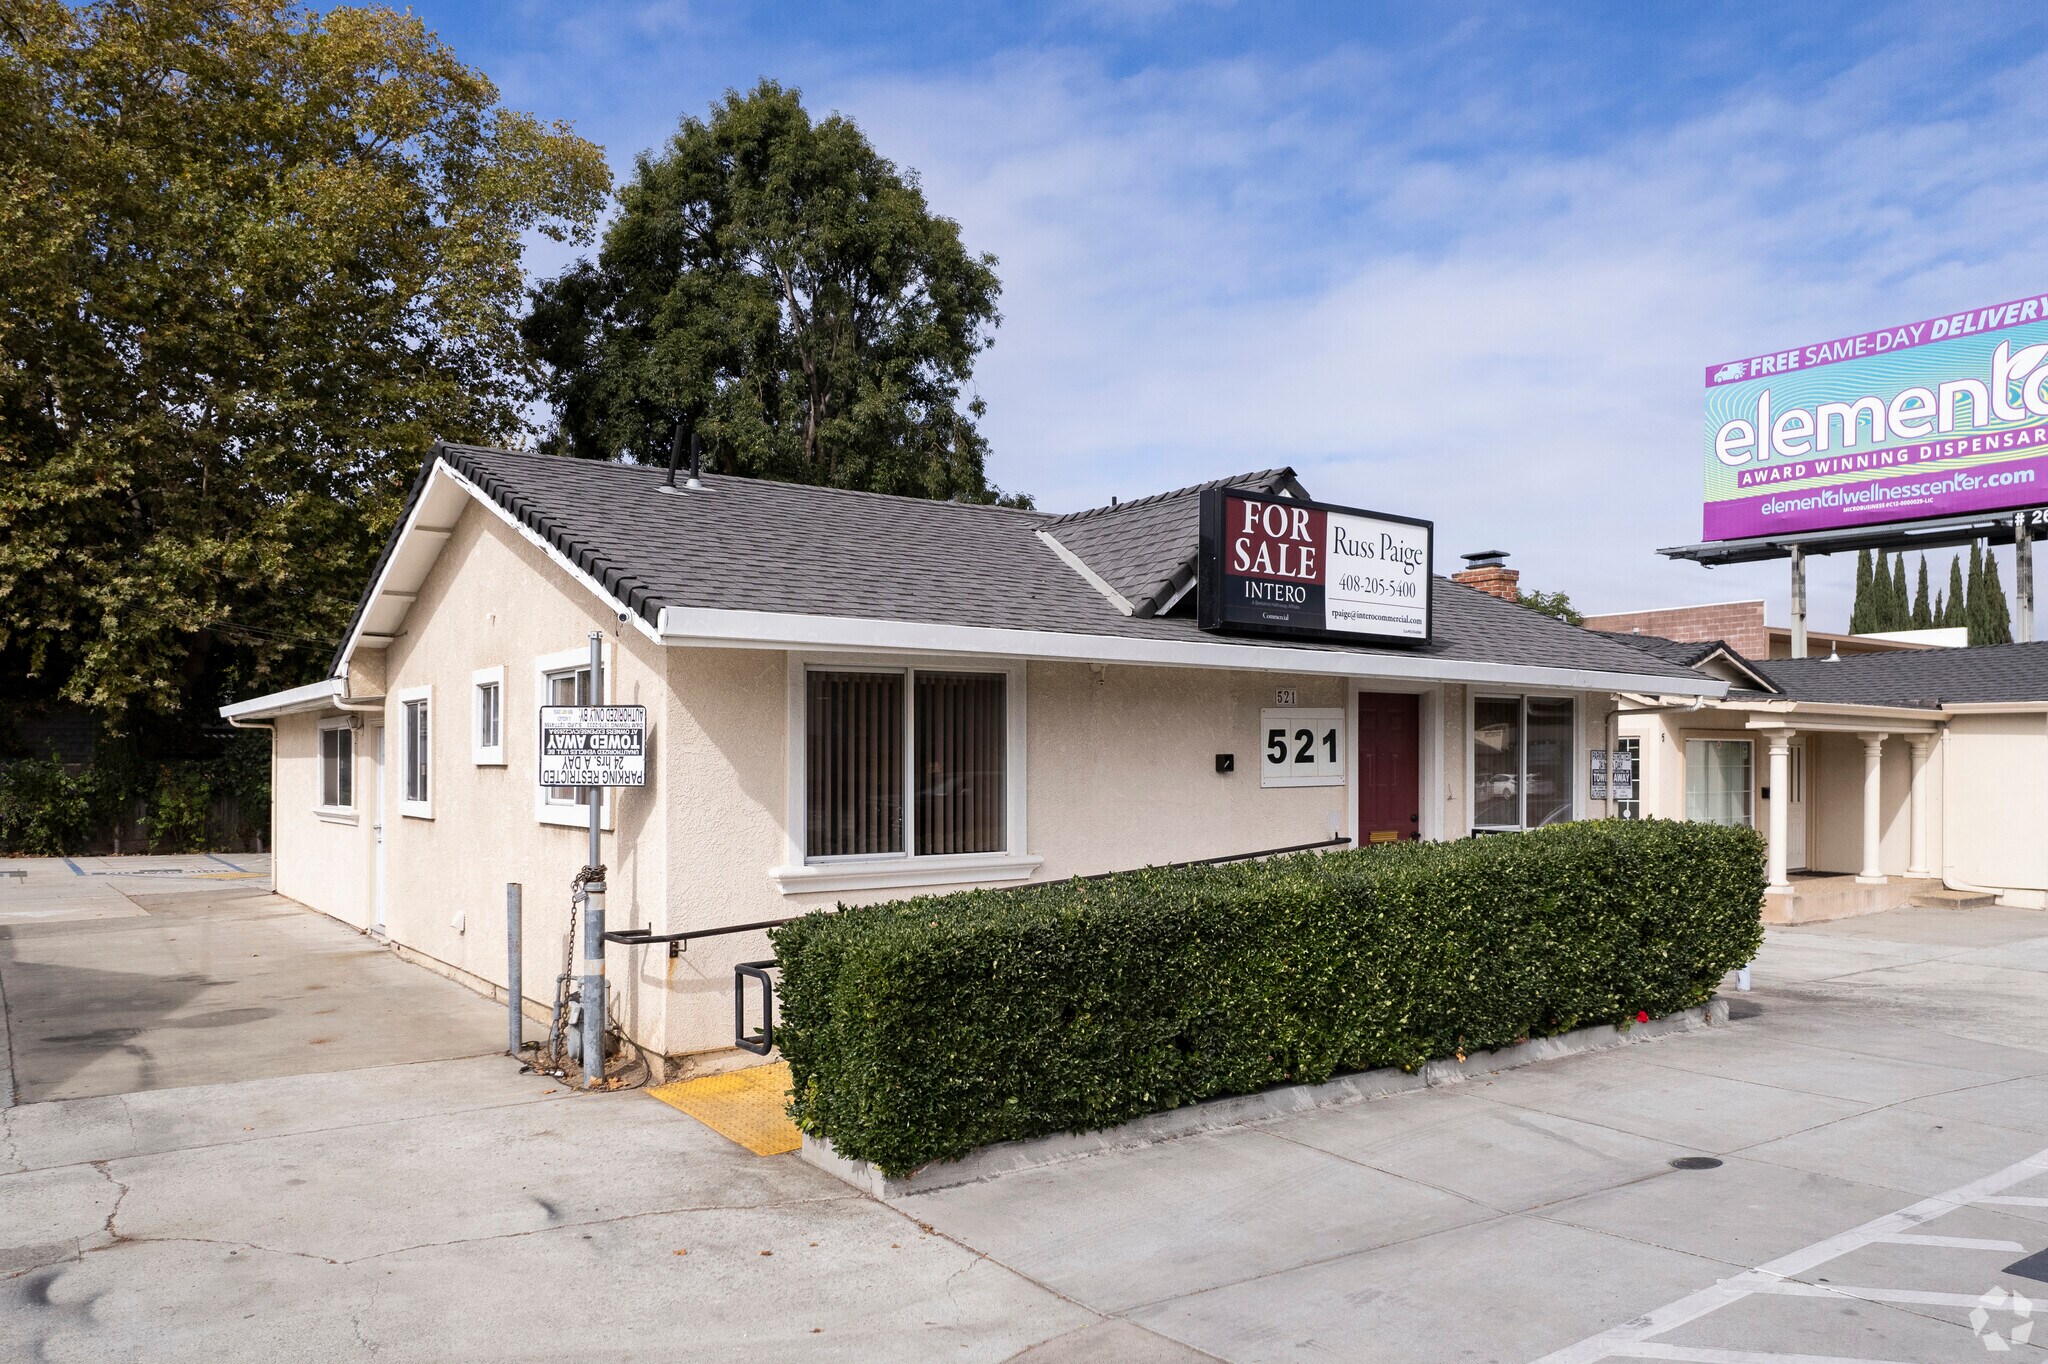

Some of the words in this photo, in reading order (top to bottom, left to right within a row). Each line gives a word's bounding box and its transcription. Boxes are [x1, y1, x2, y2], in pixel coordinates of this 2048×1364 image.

[1750, 351, 1800, 377] FREE
[1804, 323, 1926, 366] SAME-DAY
[1742, 464, 1806, 485] AWARD
[1815, 449, 1908, 474] WINNING
[1761, 468, 2035, 515] elementalwellnesscenter.com
[1843, 502, 1885, 512] MICROBUSINESS
[1242, 500, 1313, 542] FOR
[1333, 526, 1375, 559] Russ
[1380, 533, 1423, 575] Paige
[1234, 538, 1317, 579] SALE
[1245, 581, 1306, 604] INTERO
[1339, 573, 1416, 598] 408-205-5400
[1262, 612, 1289, 621] Commercial
[1332, 610, 1423, 625] rpaige@interocommercial.com
[1277, 691, 1295, 703] 521
[589, 708, 604, 722] ONLY
[606, 708, 644, 722] AUTHORIZED
[546, 735, 586, 749] AWAY
[590, 735, 640, 749] TOWED
[1267, 729, 1336, 764] 521
[562, 756, 581, 770] DAY
[584, 756, 591, 770] A
[595, 756, 610, 770] hrs.
[615, 756, 624, 770] 24
[543, 770, 599, 784] RESTRICTED
[603, 770, 642, 784] PARKING
[1614, 773, 1630, 782] AWAY
